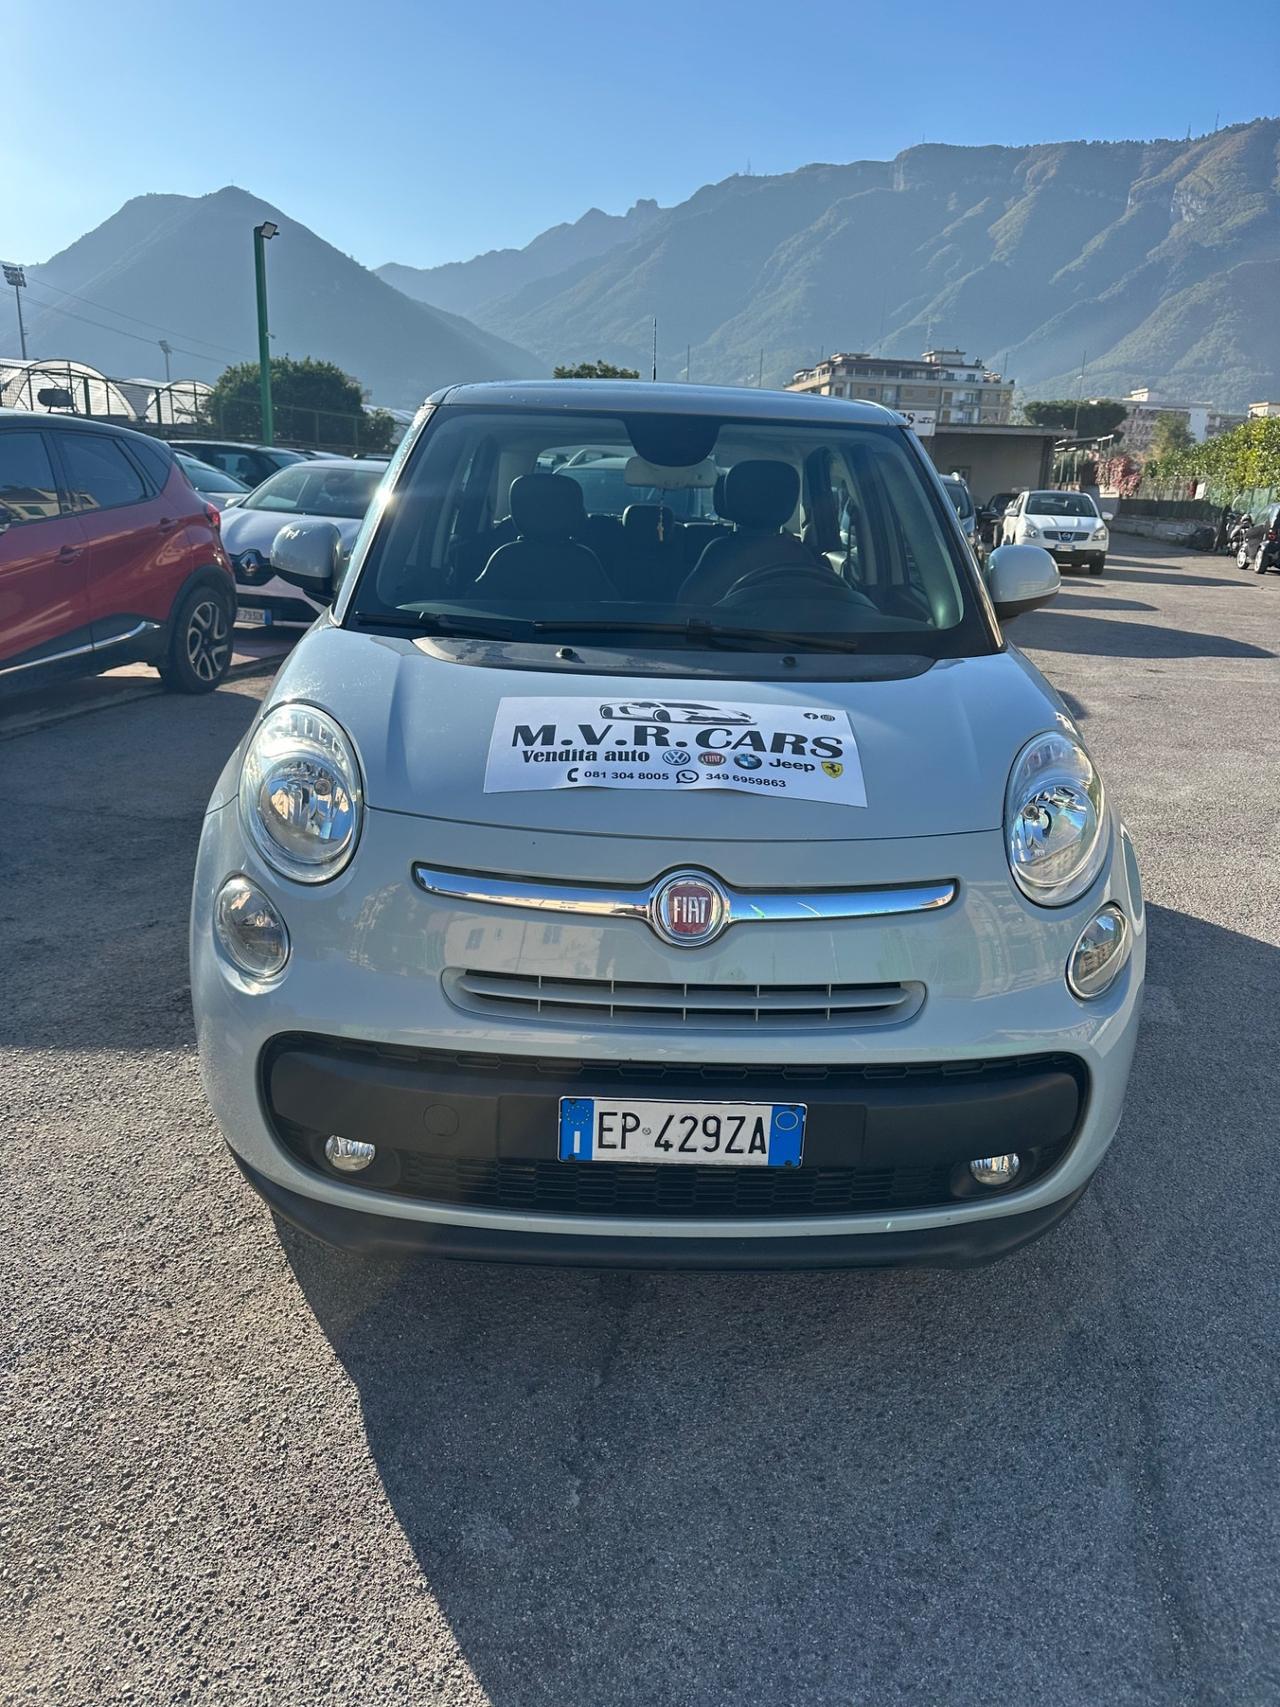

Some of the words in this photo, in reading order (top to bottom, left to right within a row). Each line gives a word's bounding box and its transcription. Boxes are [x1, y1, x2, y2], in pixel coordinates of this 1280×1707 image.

[522, 749, 598, 763] Vendita
[604, 749, 650, 763] auto
[769, 759, 816, 772] Jeep
[584, 771, 607, 779] 081
[611, 772, 634, 780] 304
[638, 772, 670, 781] 8005
[733, 774, 787, 788] 6959863
[673, 896, 708, 924] FIAT
